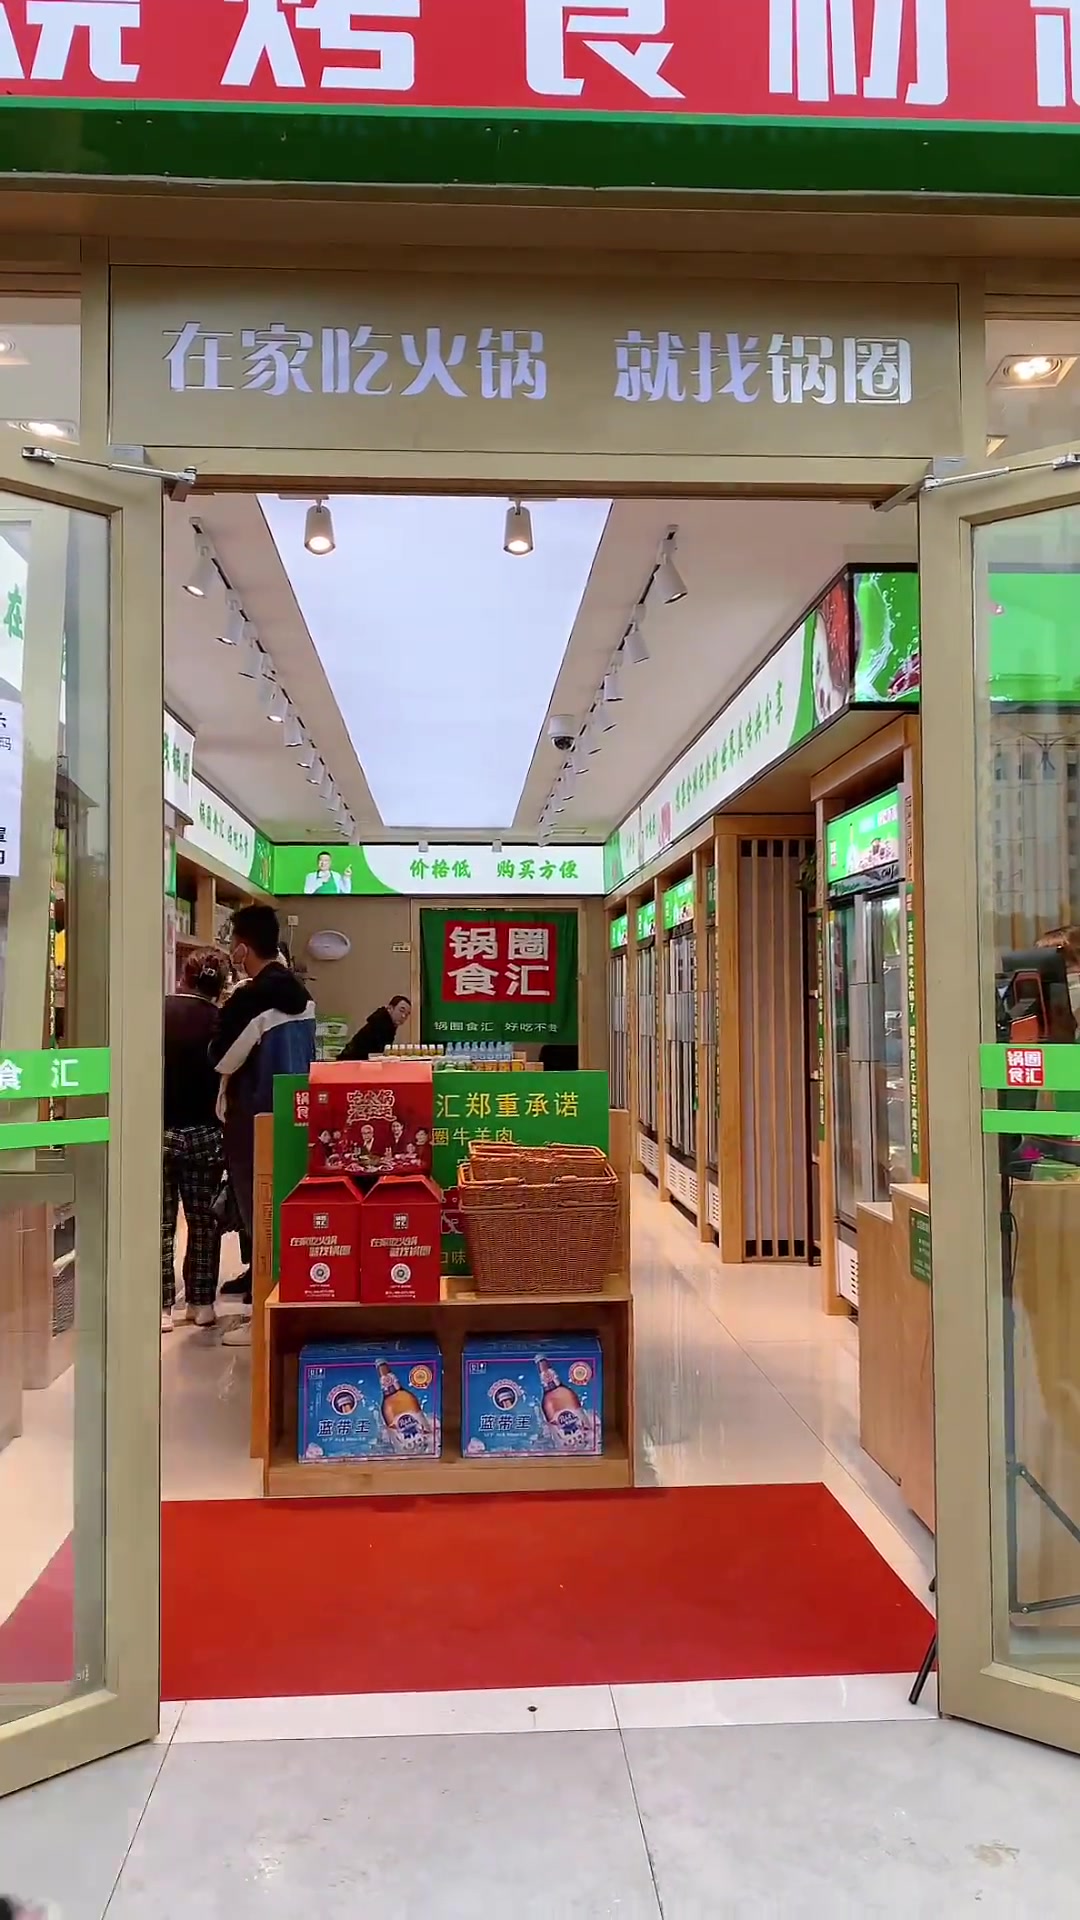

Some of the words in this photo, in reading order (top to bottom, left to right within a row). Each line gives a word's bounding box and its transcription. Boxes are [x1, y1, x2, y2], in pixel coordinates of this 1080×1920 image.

[164, 321, 547, 401] 在家吃火锅
[613, 329, 913, 406] 就找锅圈
[410, 859, 471, 880] 价格低
[497, 859, 579, 880] 购买方便
[449, 926, 549, 961] 锅圈
[447, 962, 550, 996] 食汇
[434, 1021, 494, 1031] 锅圈食汇
[504, 1022, 559, 1033] 好吃不贵
[1007, 1051, 1042, 1067] 锅圈
[1008, 1067, 1042, 1083] 食汇
[436, 1091, 579, 1118] 汇郑重承诺
[432, 1127, 513, 1146] 圈牛羊肉
[317, 1419, 370, 1436] 蓝带王
[479, 1414, 532, 1432] 蓝带王
